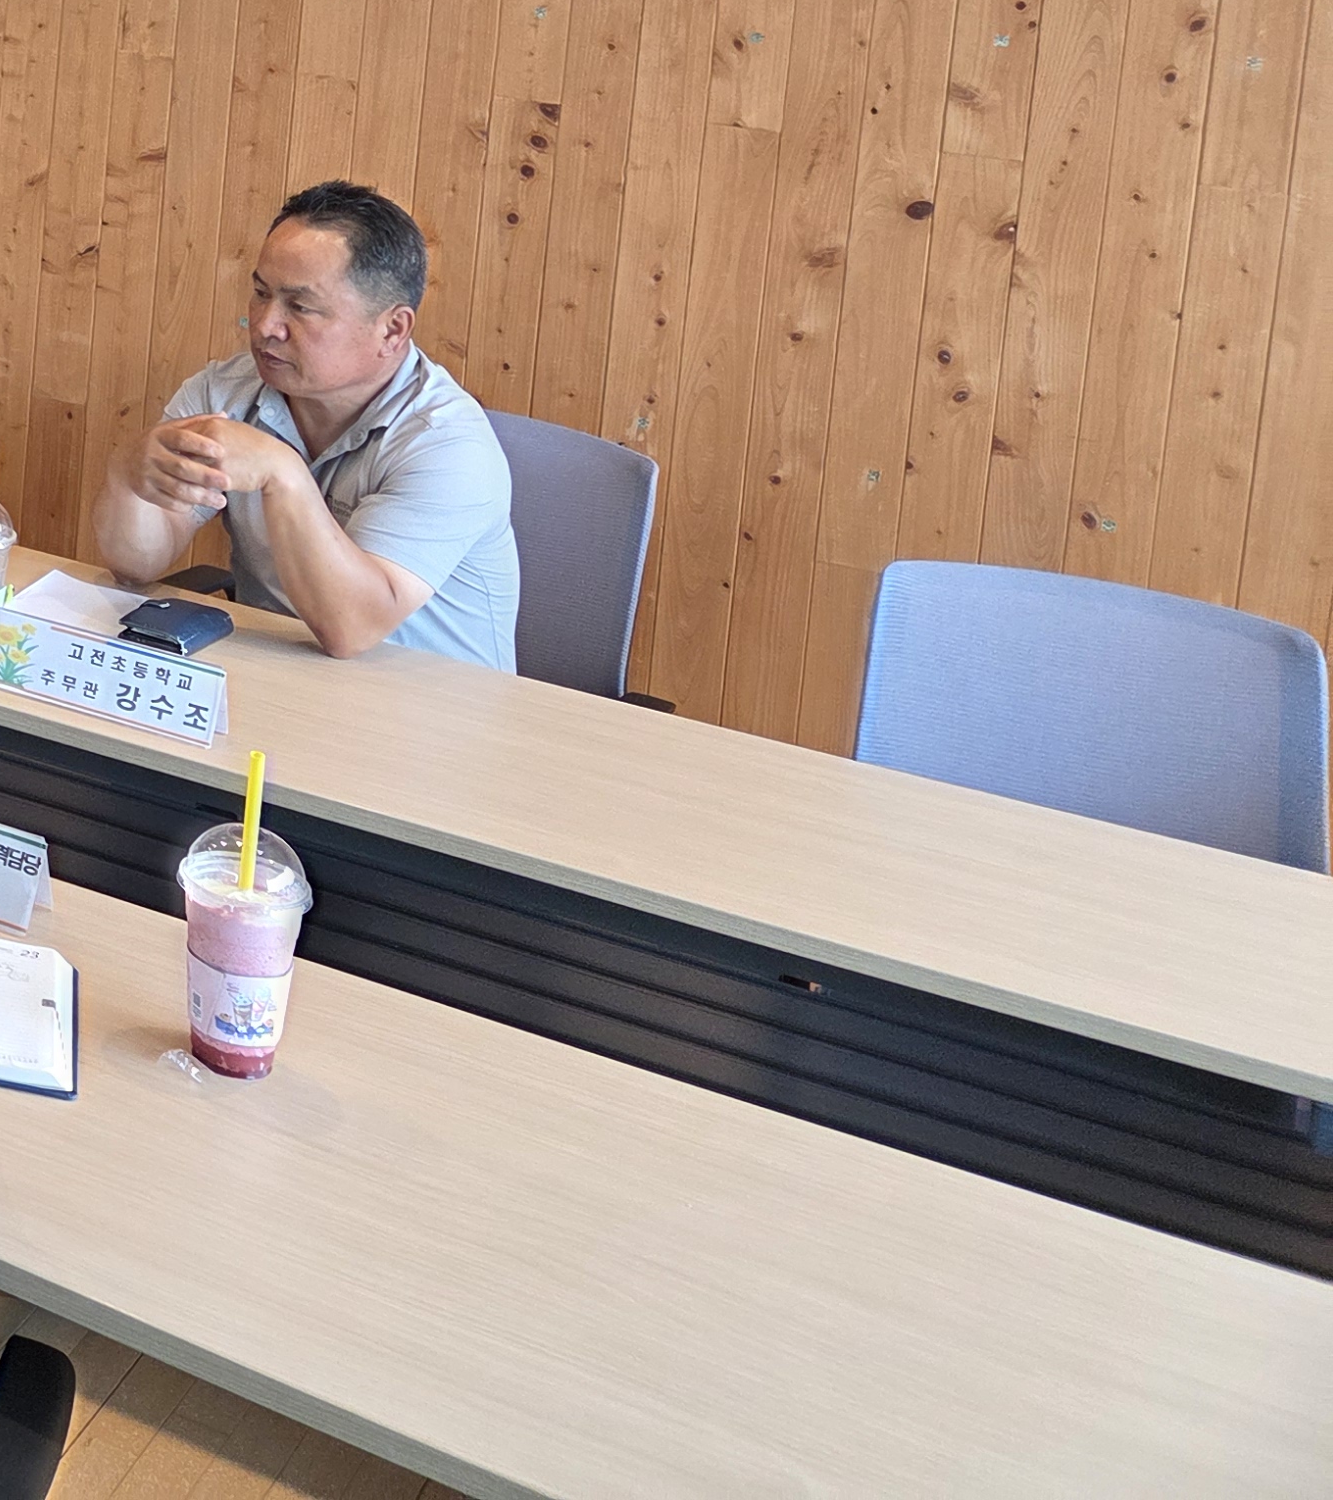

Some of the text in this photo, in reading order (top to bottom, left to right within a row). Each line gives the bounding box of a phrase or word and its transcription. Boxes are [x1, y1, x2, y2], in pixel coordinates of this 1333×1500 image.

[68, 643, 194, 691] 고전초등학교
[40, 669, 210, 732] 주무관 강수조
